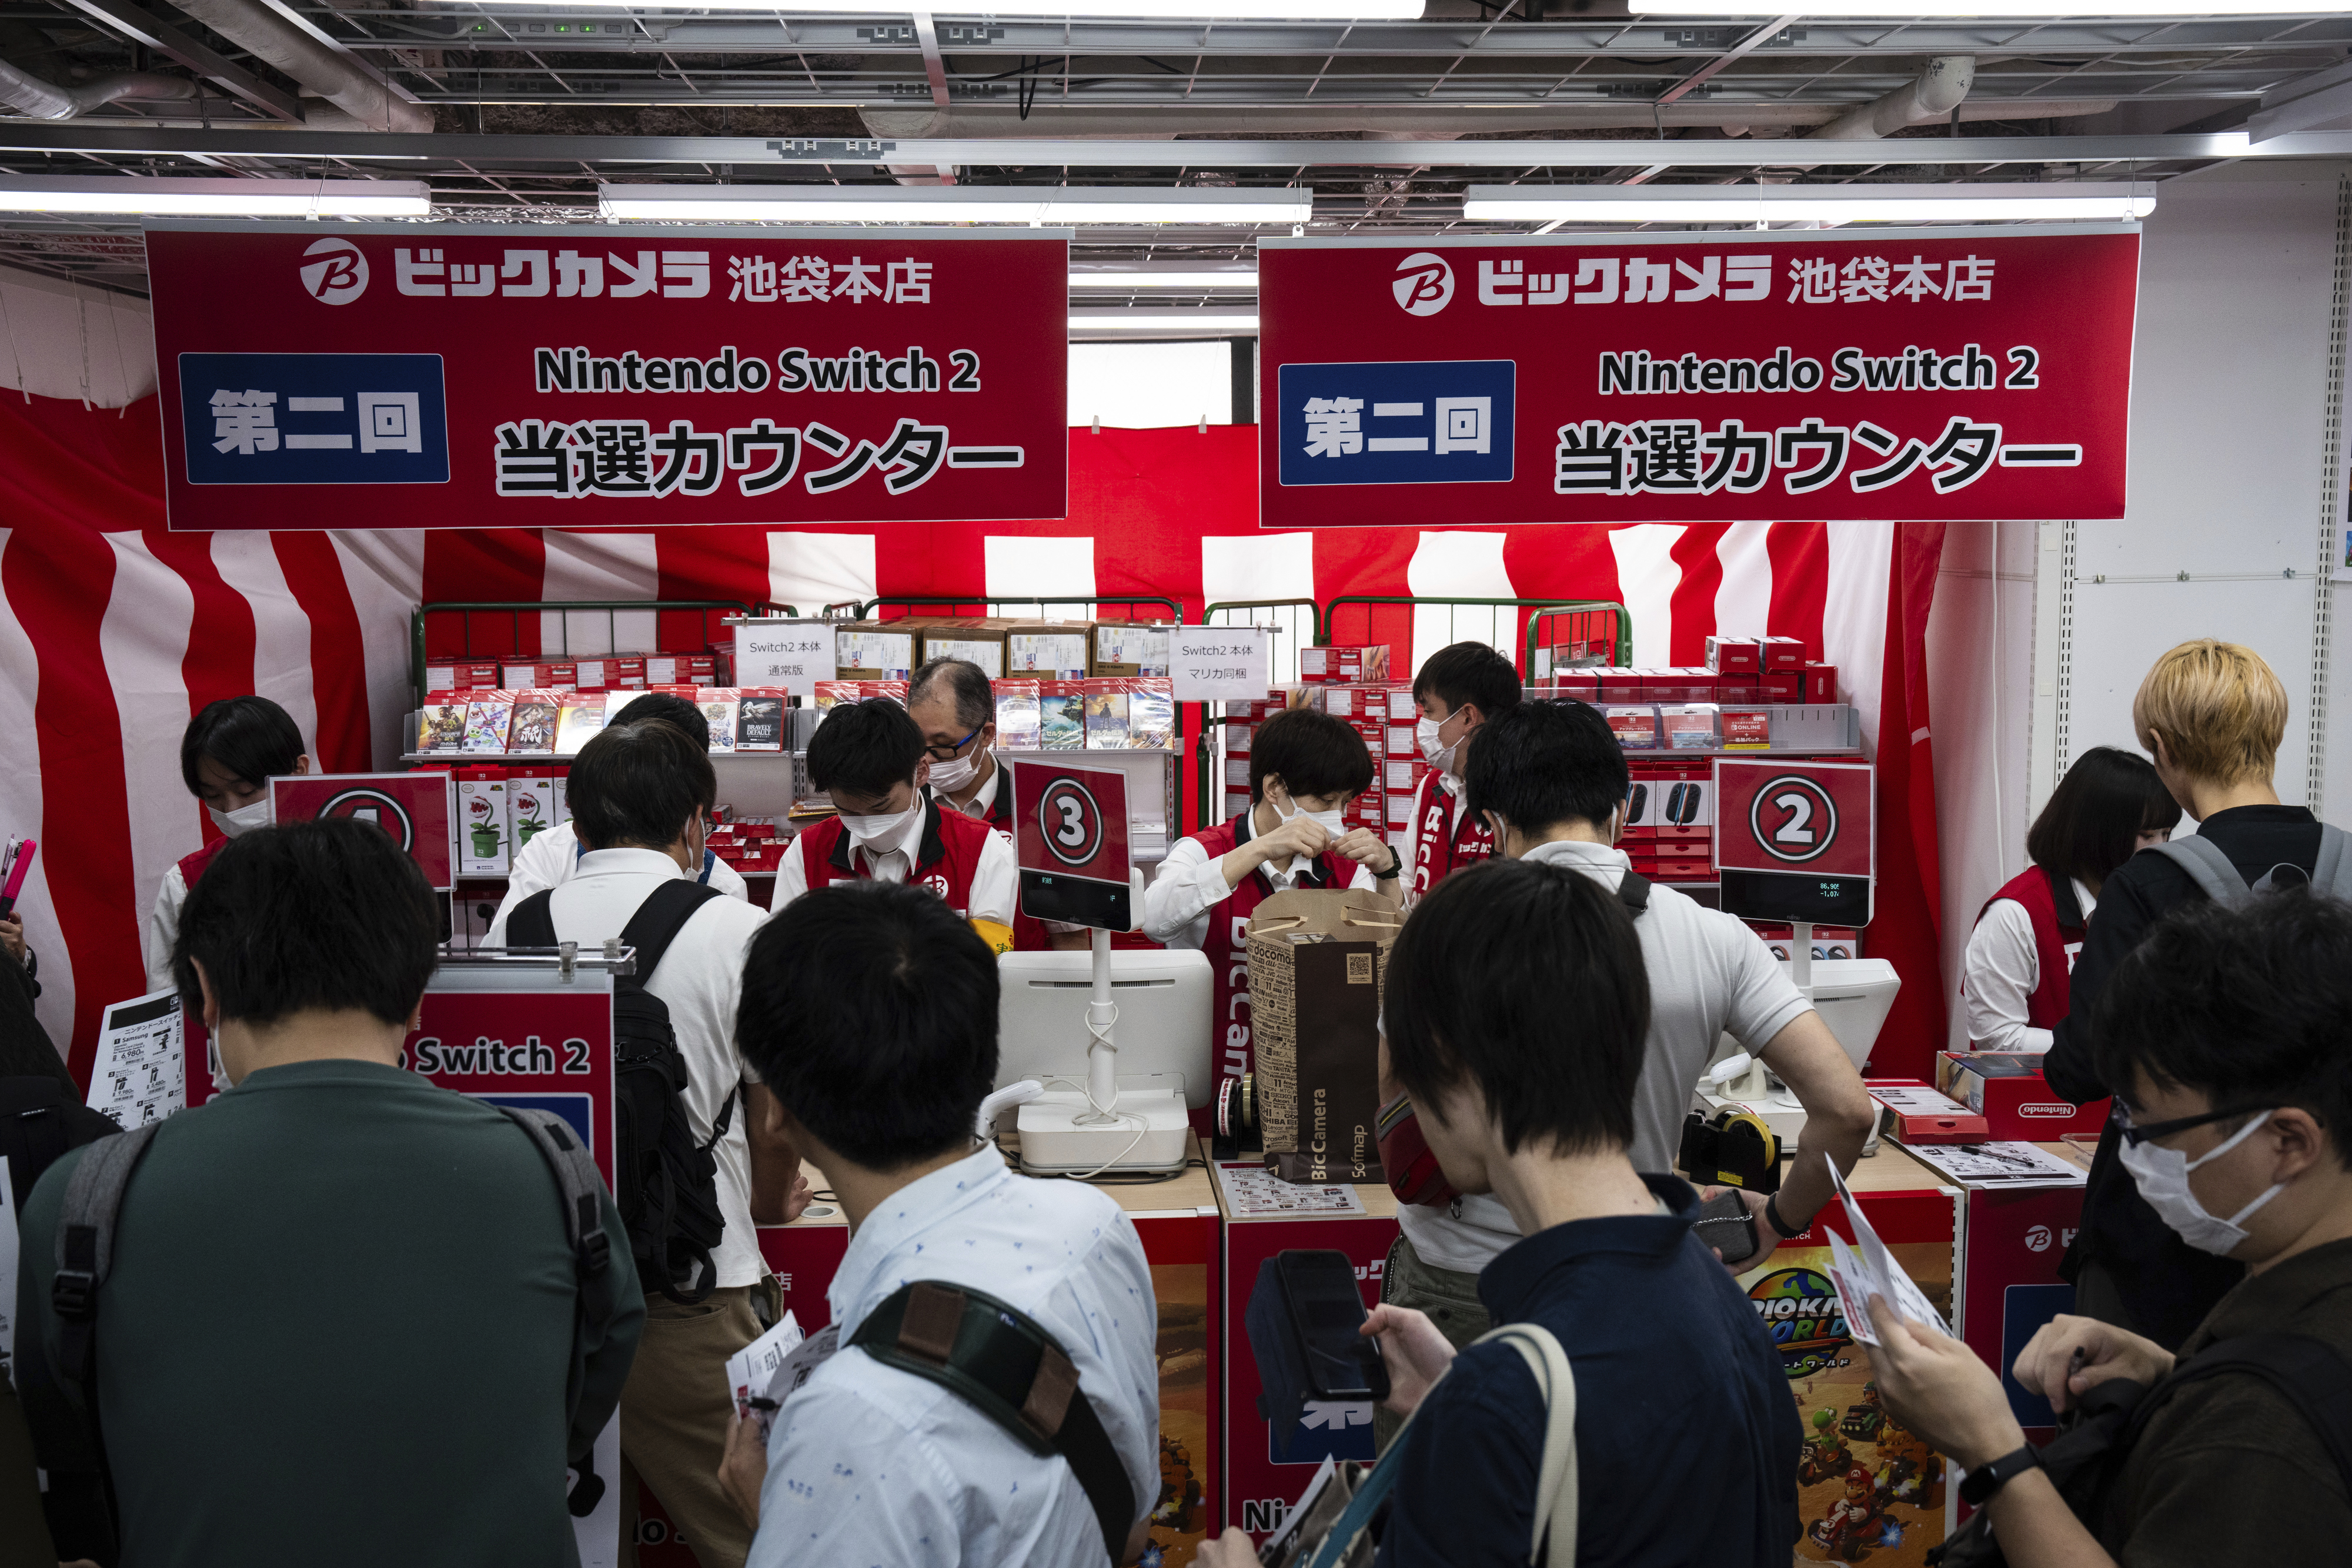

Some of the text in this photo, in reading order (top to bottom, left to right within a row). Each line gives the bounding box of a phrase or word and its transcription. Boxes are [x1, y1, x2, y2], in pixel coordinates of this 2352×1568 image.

[395, 249, 933, 304] ビックカメラ 池袋本店
[1478, 255, 1996, 306] ビックカメラ 池袋本店
[535, 346, 980, 393] Nintendo Switch 2
[1598, 344, 2039, 395] Nintendo Switch 2
[208, 389, 423, 454] 第二回
[1302, 397, 1492, 457] 第二回
[495, 417, 1024, 498] 当選カウンター
[1554, 416, 2082, 495] 当選カウンター
[750, 641, 821, 653] Switch2 本体
[1182, 644, 1253, 656] Switch2 本体
[768, 665, 804, 677] 通常版
[1188, 667, 1247, 680] マリカ同梱
[1254, 943, 1291, 964] docomo
[1265, 943, 1284, 953] SEIKO
[122, 1033, 148, 1043] Samsung
[1262, 1021, 1275, 1030] Nikon
[415, 1036, 591, 1075] Switch 2
[2024, 1105, 2072, 1115] Nintendo
[1311, 1088, 1327, 1181] BicCamera
[1351, 1125, 1368, 1178] Sofmap
[1767, 1318, 1849, 1343] ORLD
